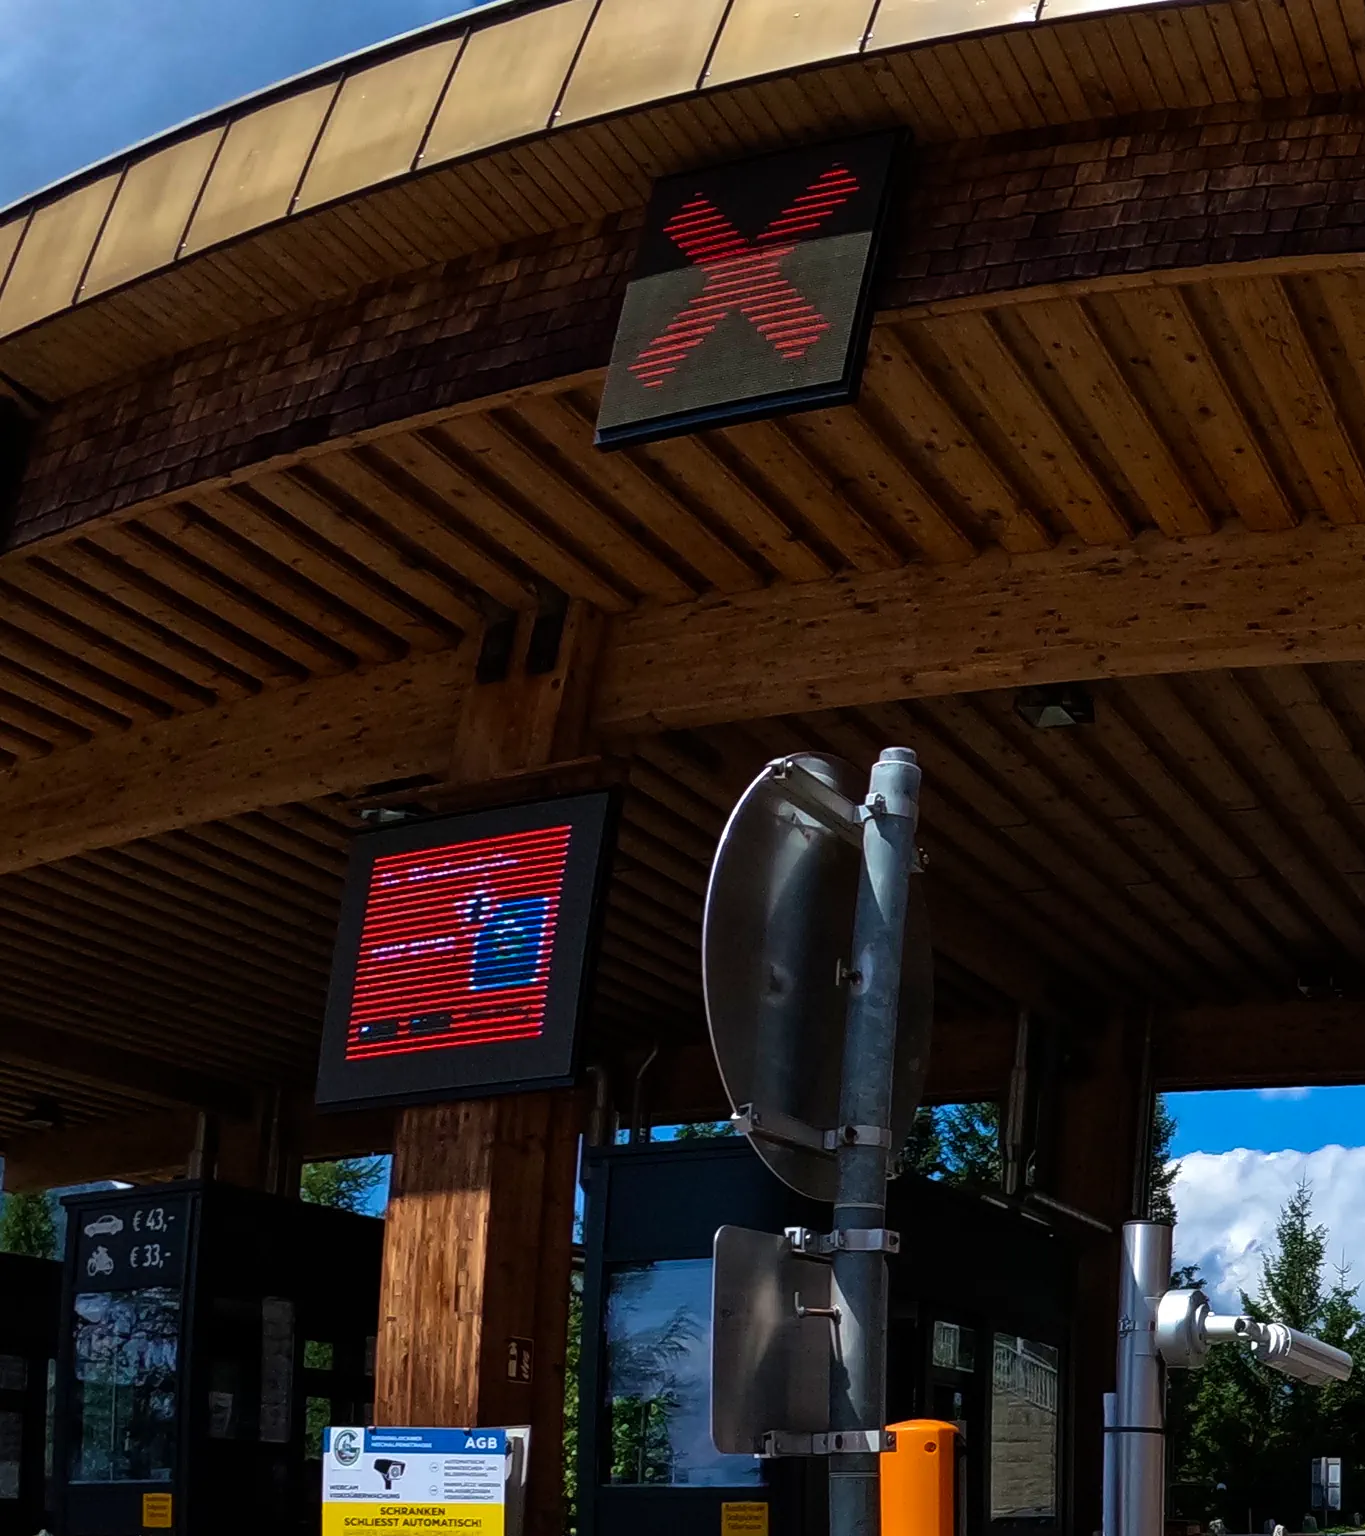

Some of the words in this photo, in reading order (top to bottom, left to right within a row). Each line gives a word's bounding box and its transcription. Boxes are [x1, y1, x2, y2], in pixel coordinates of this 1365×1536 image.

[133, 1210, 143, 1232] €
[130, 1247, 139, 1268] €
[464, 1437, 498, 1449] AGB
[380, 1507, 446, 1516] SCHRANKEN
[344, 1518, 400, 1527] SCHLIESST
[402, 1518, 482, 1528] AUTOMATISCH!
